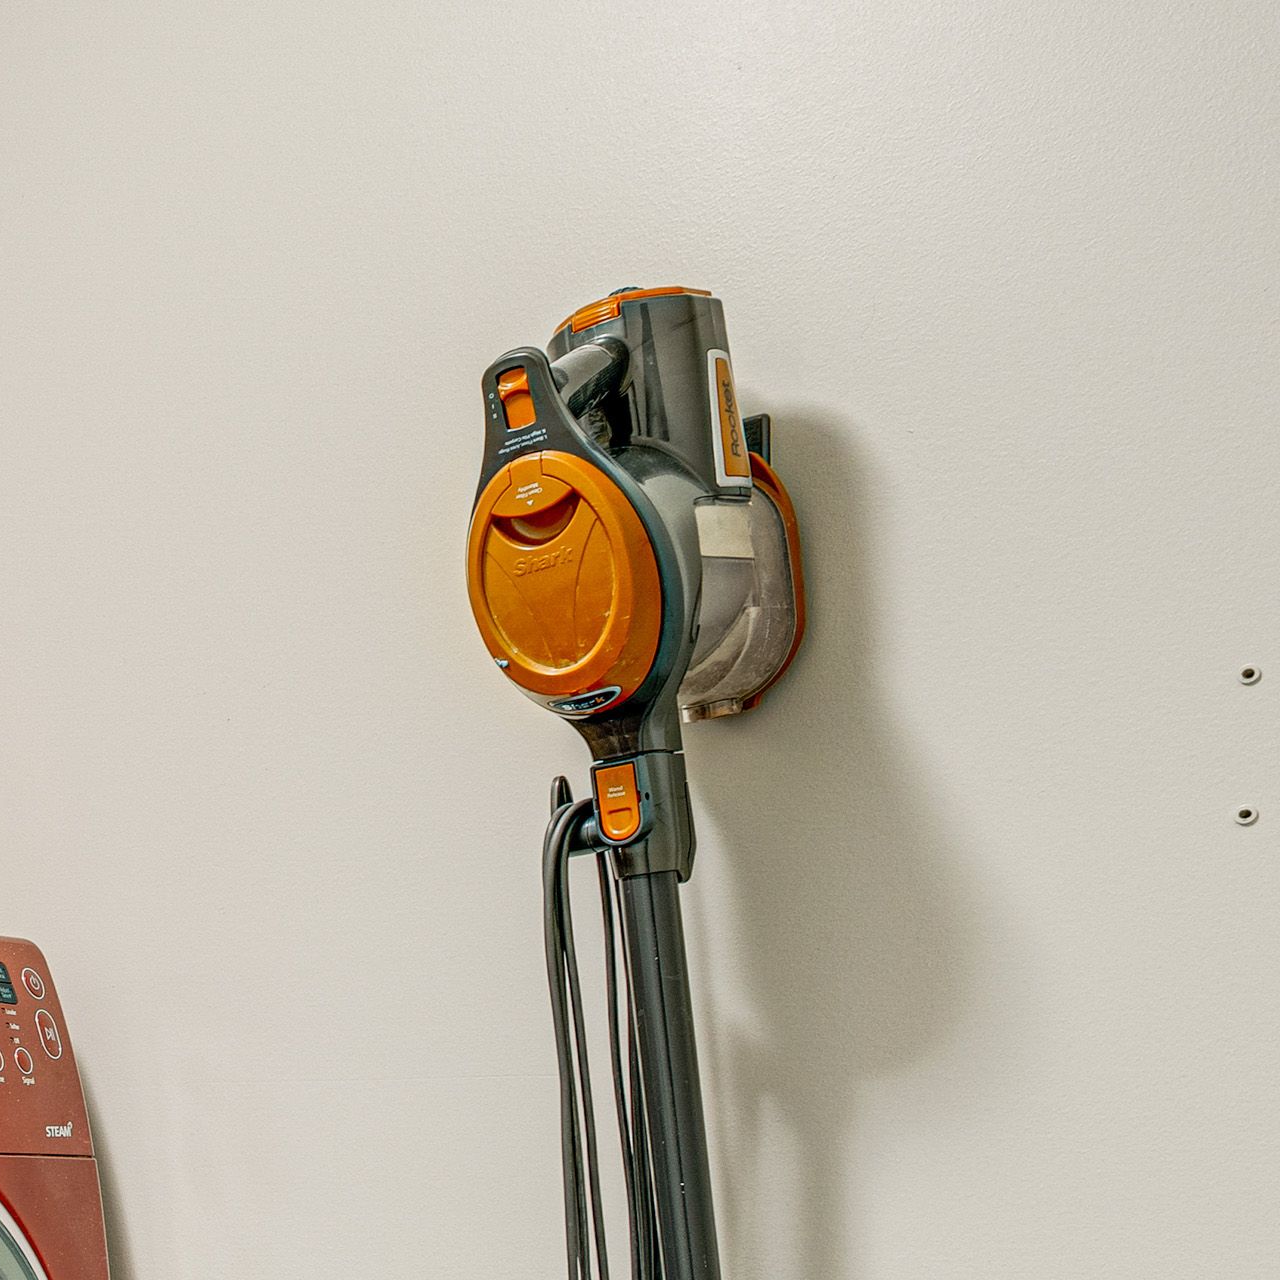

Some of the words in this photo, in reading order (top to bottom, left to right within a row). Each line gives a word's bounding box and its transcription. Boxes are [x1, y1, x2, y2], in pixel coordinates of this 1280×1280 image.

[721, 379, 742, 458] Rocket
[513, 545, 573, 578] Shark
[562, 696, 605, 711] Shark
[46, 1125, 72, 1137] STEAM
